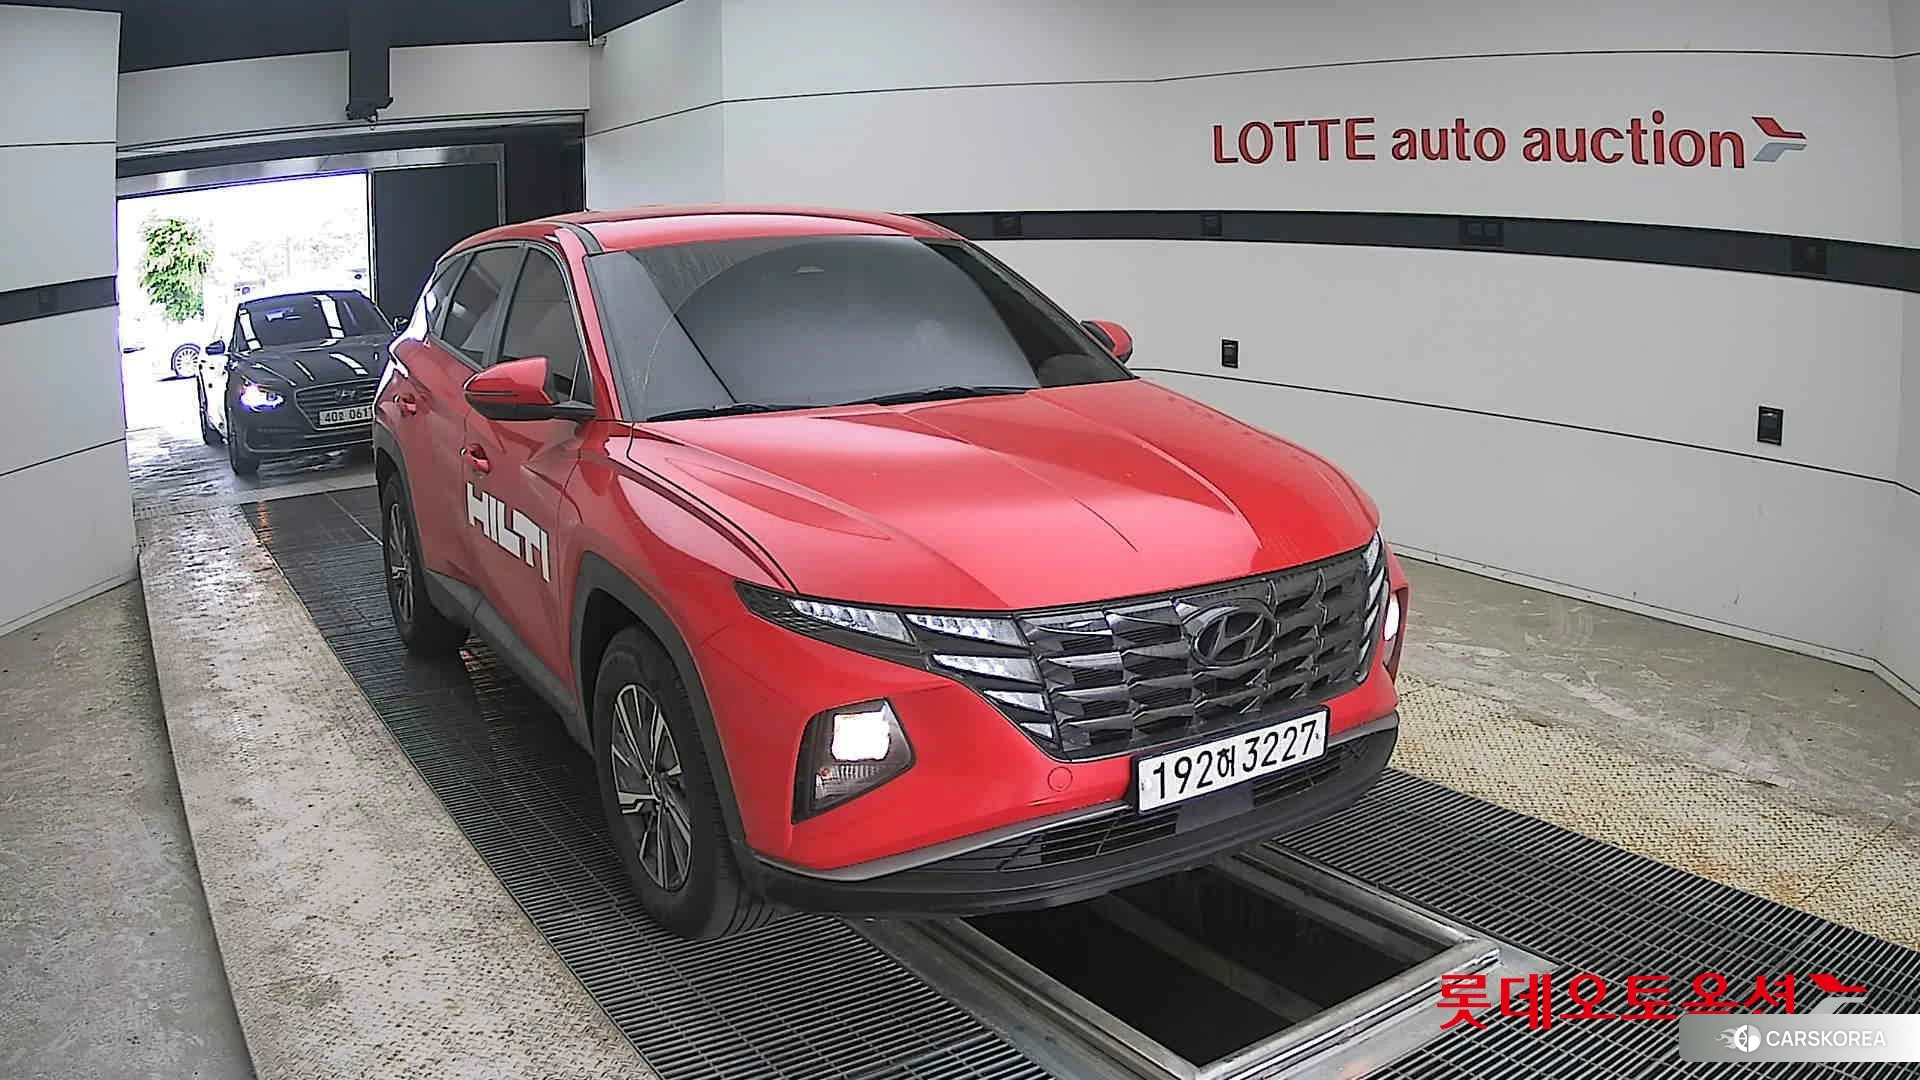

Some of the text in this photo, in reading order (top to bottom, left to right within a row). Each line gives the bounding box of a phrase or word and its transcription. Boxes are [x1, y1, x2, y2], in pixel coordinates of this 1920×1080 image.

[1213, 110, 1745, 169] LOTTE auto auction
[466, 481, 550, 582] HILTI
[1241, 719, 1318, 773] 3227
